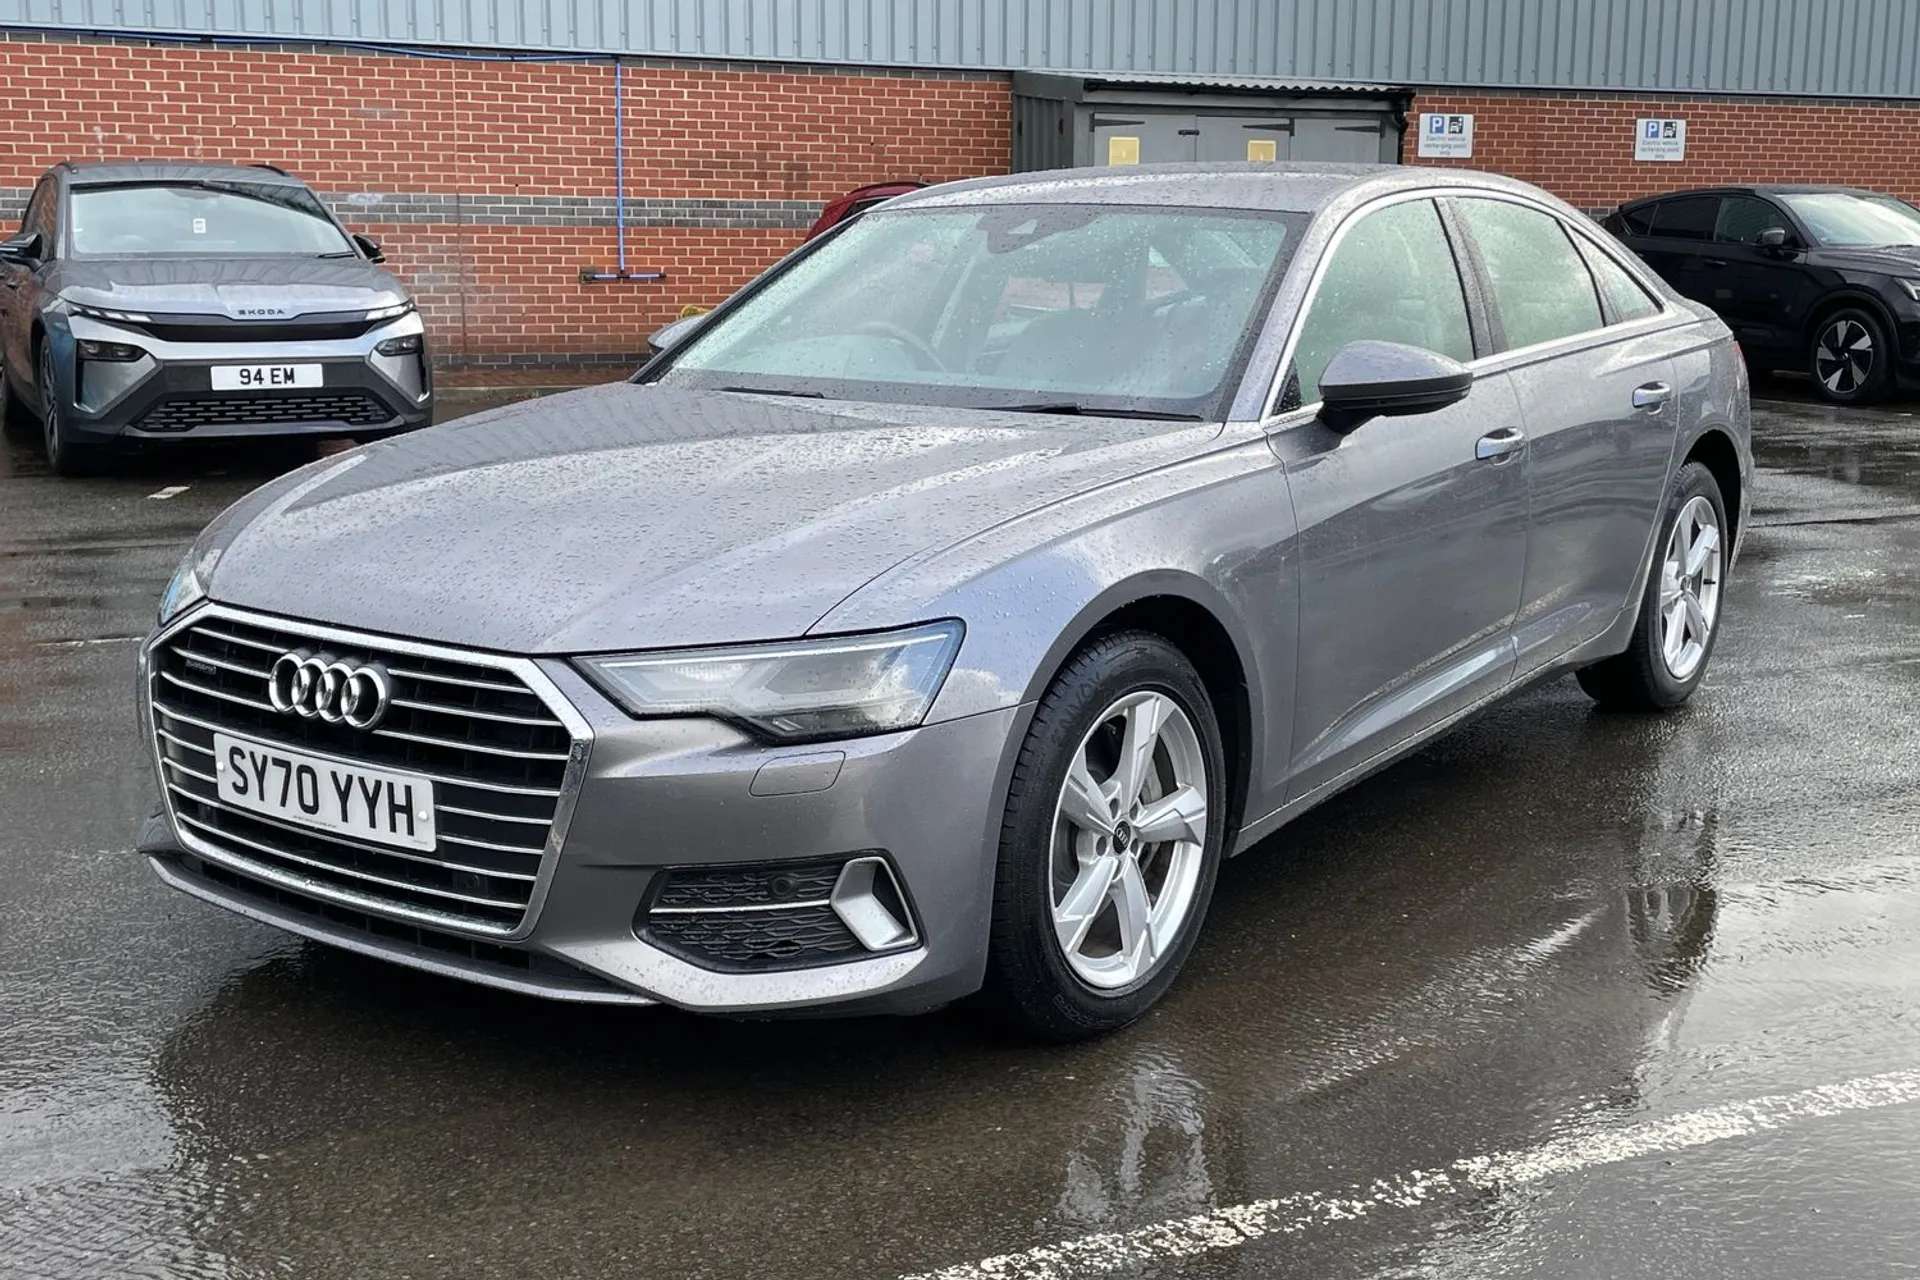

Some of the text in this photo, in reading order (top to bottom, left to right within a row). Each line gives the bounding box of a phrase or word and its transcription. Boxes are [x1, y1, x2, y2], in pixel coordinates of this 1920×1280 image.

[1432, 117, 1443, 133] P
[1648, 122, 1658, 137] P
[240, 367, 295, 385] 94 EM
[229, 746, 415, 837] SY70 YYH
